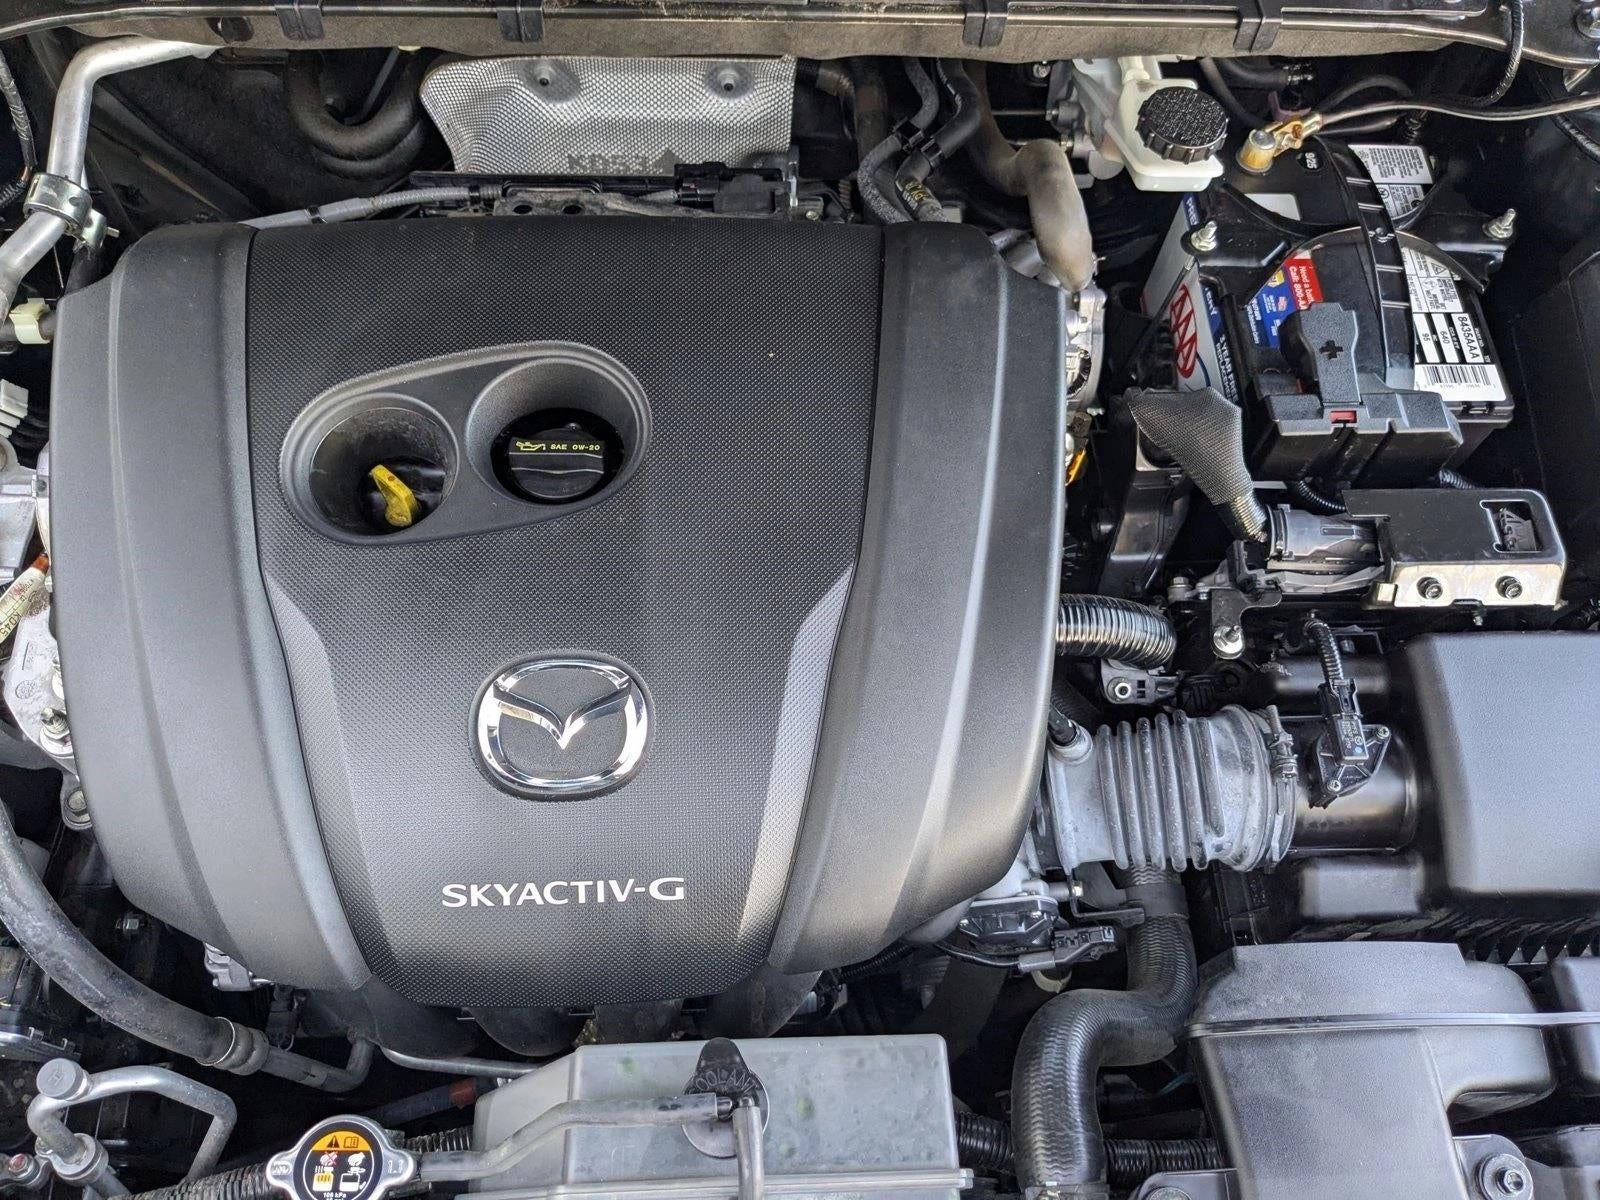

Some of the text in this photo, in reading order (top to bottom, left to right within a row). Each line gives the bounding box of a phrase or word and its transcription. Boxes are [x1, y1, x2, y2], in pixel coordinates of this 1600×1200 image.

[1304, 151, 1317, 169] 9/25
[1170, 284, 1198, 379] AAA
[1422, 333, 1431, 342] 95
[1440, 331, 1450, 344] 640
[1457, 316, 1480, 359] 8435AAA
[1222, 343, 1232, 373] YEAR
[441, 877, 685, 907] SKYACTIV-G
